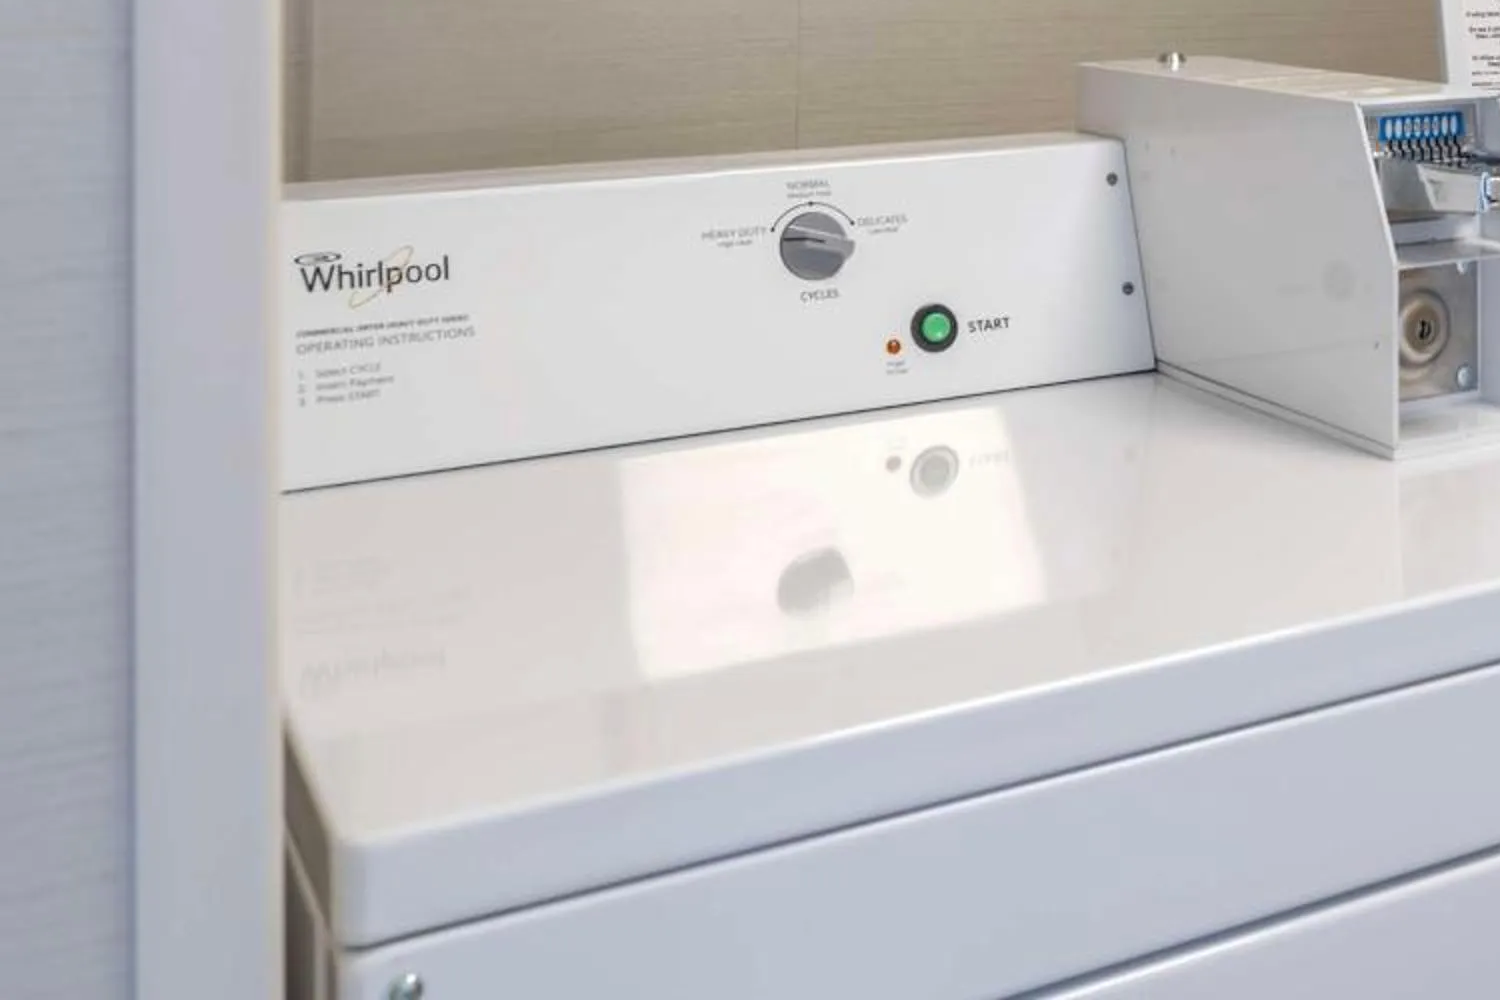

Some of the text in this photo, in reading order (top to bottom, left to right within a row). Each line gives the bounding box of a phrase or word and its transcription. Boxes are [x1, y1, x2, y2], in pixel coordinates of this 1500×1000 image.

[701, 226, 767, 240] HEAVY DUTY
[299, 253, 450, 293] Whirlpool
[799, 288, 840, 304] CYCLES
[967, 316, 1011, 333] START
[295, 335, 375, 355] OPERATING
[378, 325, 476, 347] INSTRUCTIONS
